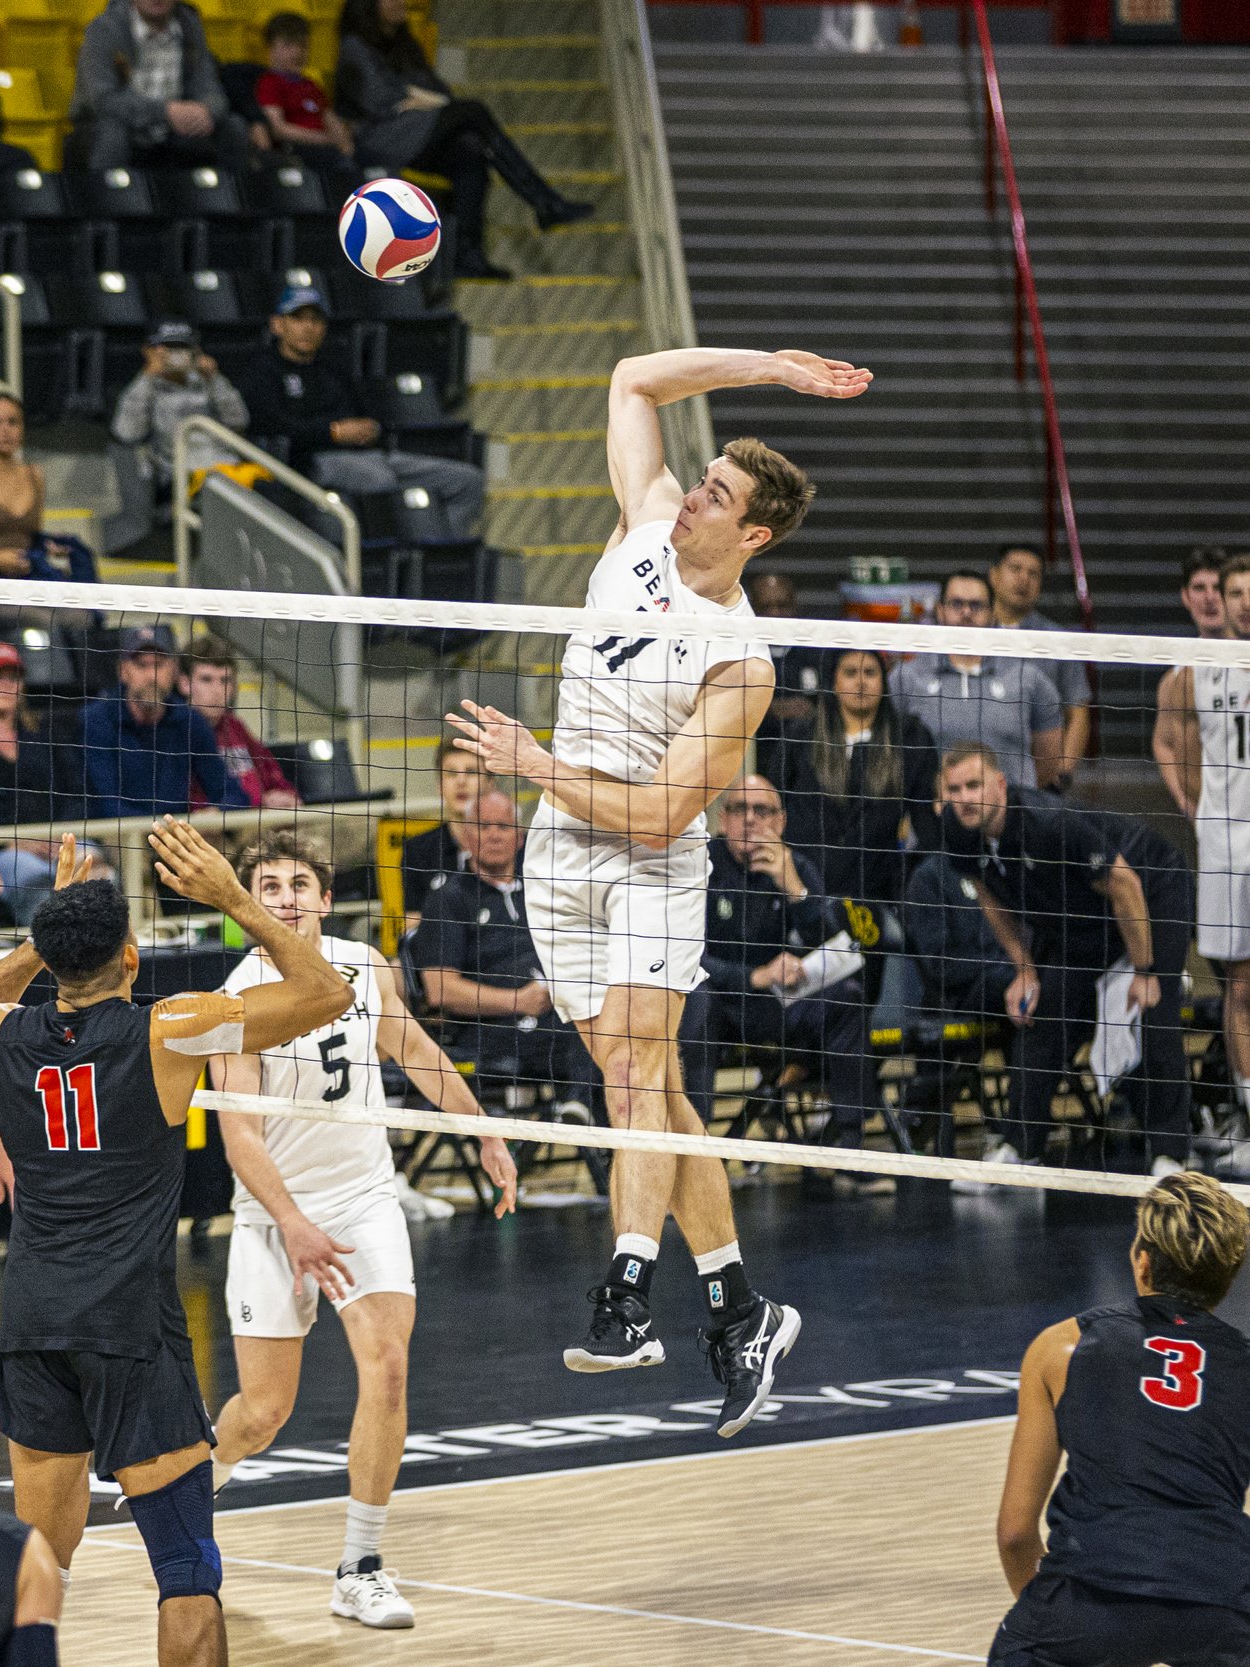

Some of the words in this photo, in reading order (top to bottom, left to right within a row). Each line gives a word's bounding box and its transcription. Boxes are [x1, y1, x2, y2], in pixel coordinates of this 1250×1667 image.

[318, 1032, 351, 1102] 5
[34, 1062, 102, 1151] 11
[1139, 1335, 1207, 1412] 3
